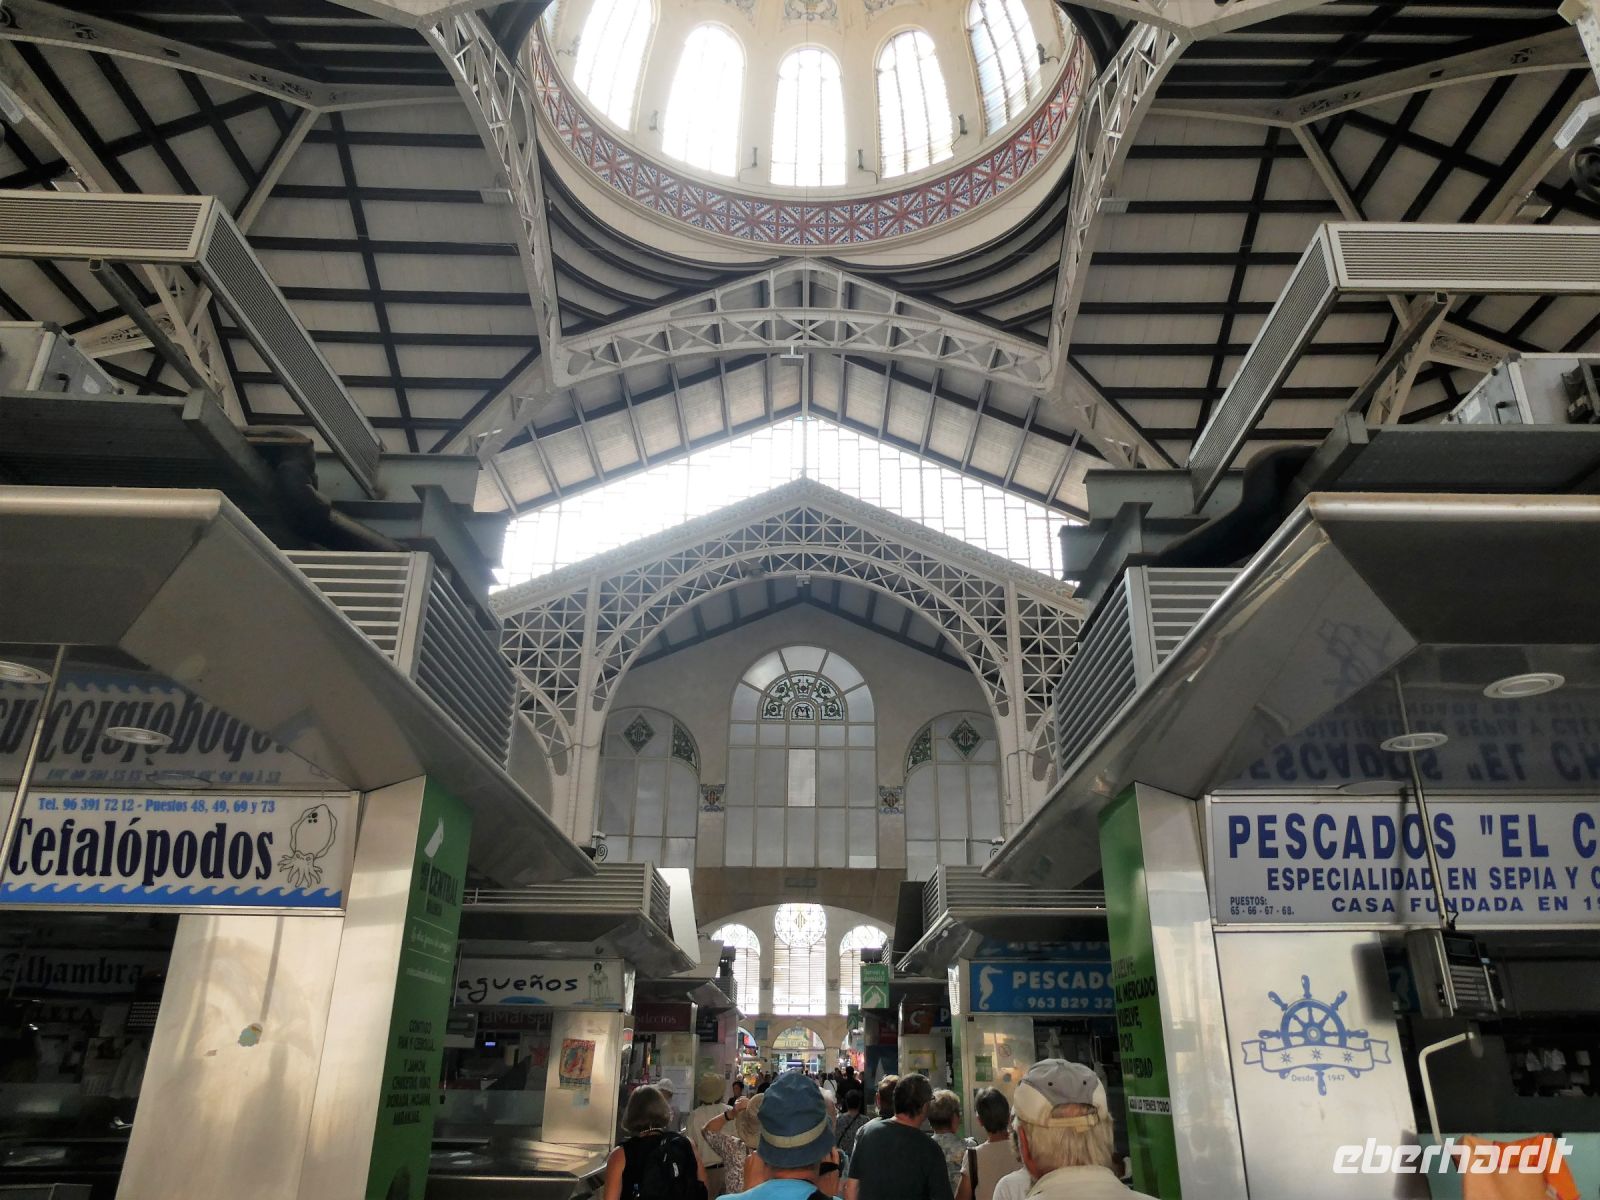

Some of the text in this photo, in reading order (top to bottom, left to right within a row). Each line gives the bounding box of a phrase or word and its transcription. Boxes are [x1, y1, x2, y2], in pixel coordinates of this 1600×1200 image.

[38, 797, 59, 811] Tel.
[62, 798, 77, 811] 96
[80, 798, 100, 811] 391
[104, 798, 119, 811] 72
[121, 799, 135, 811] 12
[145, 798, 188, 812] Puestos
[190, 799, 208, 813] 48,
[212, 800, 230, 814] 49,
[250, 803, 258, 814] y
[261, 800, 275, 813] 73
[1228, 812, 1597, 860] PESCADOS "EL C
[9, 817, 274, 886] Cefalópodos
[1267, 866, 1436, 891] ESPECIALIDAD
[1447, 867, 1476, 890] EN
[1489, 866, 1557, 890] SEPIA
[1565, 866, 1579, 890] Y
[1230, 896, 1267, 906] PUESTOS:
[1331, 897, 1395, 912] CASA
[1411, 896, 1524, 912] FUNDADA
[1538, 896, 1568, 911] EN
[1230, 906, 1240, 915] 65
[1264, 906, 1273, 915] 67
[1126, 976, 1156, 1001] MERCADO
[1027, 997, 1056, 1009] 963
[1061, 997, 1088, 1009] 829
[1291, 1074, 1315, 1082] Desde
